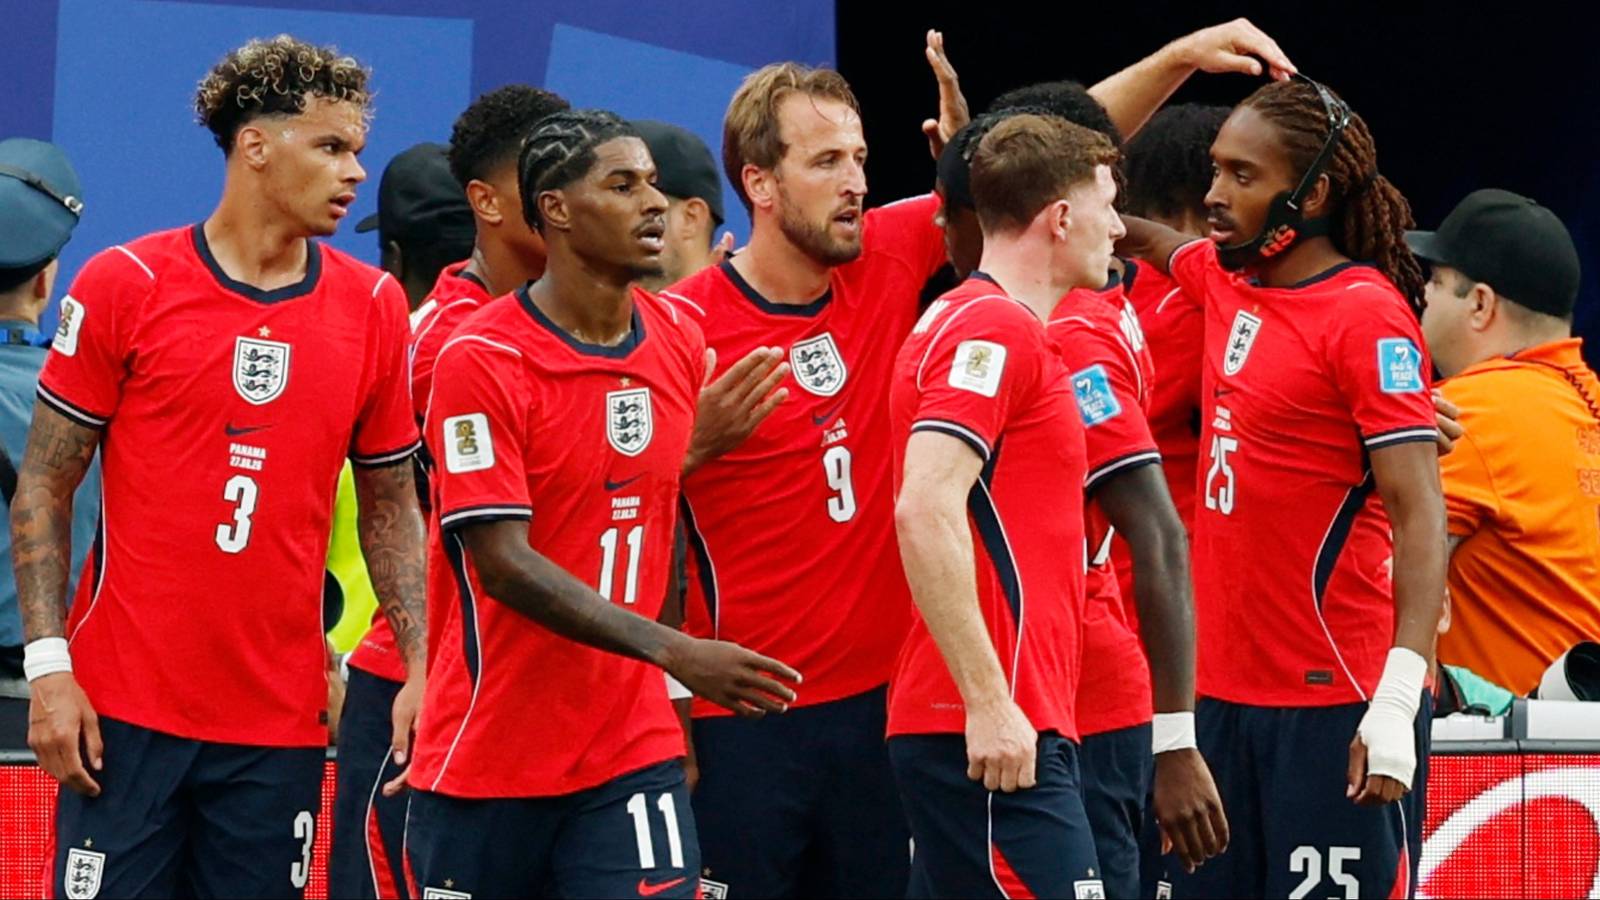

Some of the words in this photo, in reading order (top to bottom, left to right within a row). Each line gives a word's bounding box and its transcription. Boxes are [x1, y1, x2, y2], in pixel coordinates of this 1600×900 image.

[229, 443, 267, 460] PANAMA
[823, 446, 856, 522] 9
[1205, 433, 1238, 515] 25
[215, 474, 259, 554] 3
[600, 526, 643, 603] 11
[290, 810, 314, 888] 3
[627, 793, 684, 868] 11
[1289, 845, 1361, 899] 25
